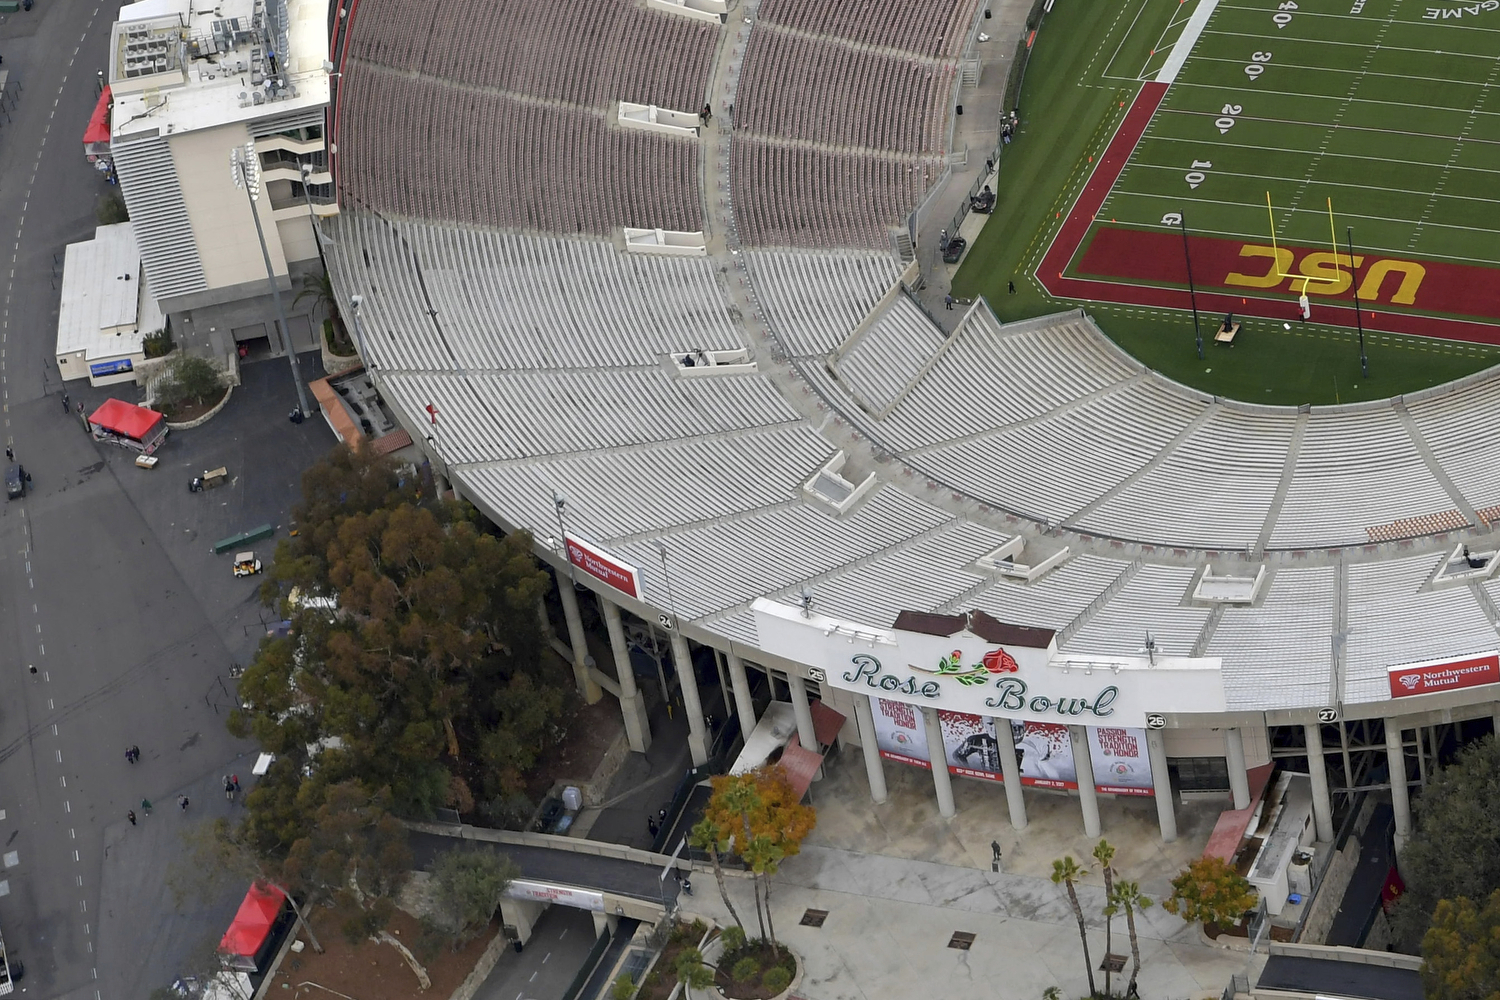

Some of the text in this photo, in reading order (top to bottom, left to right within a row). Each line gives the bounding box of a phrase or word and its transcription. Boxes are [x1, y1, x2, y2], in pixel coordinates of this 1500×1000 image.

[1273, 0, 1299, 25] 40
[1422, 0, 1500, 20] GAME
[1244, 50, 1272, 76] 30
[1214, 103, 1243, 129] 20
[1185, 159, 1212, 186] 10
[1161, 212, 1182, 226] G
[1224, 244, 1426, 306] USC
[584, 554, 628, 582] Northwestern
[586, 561, 608, 580] Mutual
[660, 615, 672, 628] 24
[810, 668, 824, 680] 25
[1423, 664, 1490, 680] Northwestern
[842, 653, 1120, 718] Rose Bowl
[1424, 674, 1460, 688] Mutual
[1148, 714, 1164, 728] 26
[1320, 709, 1336, 721] 27
[1098, 734, 1136, 743] STRENGTH
[1100, 741, 1138, 750] TRADITION
[1114, 750, 1138, 758] HONOR
